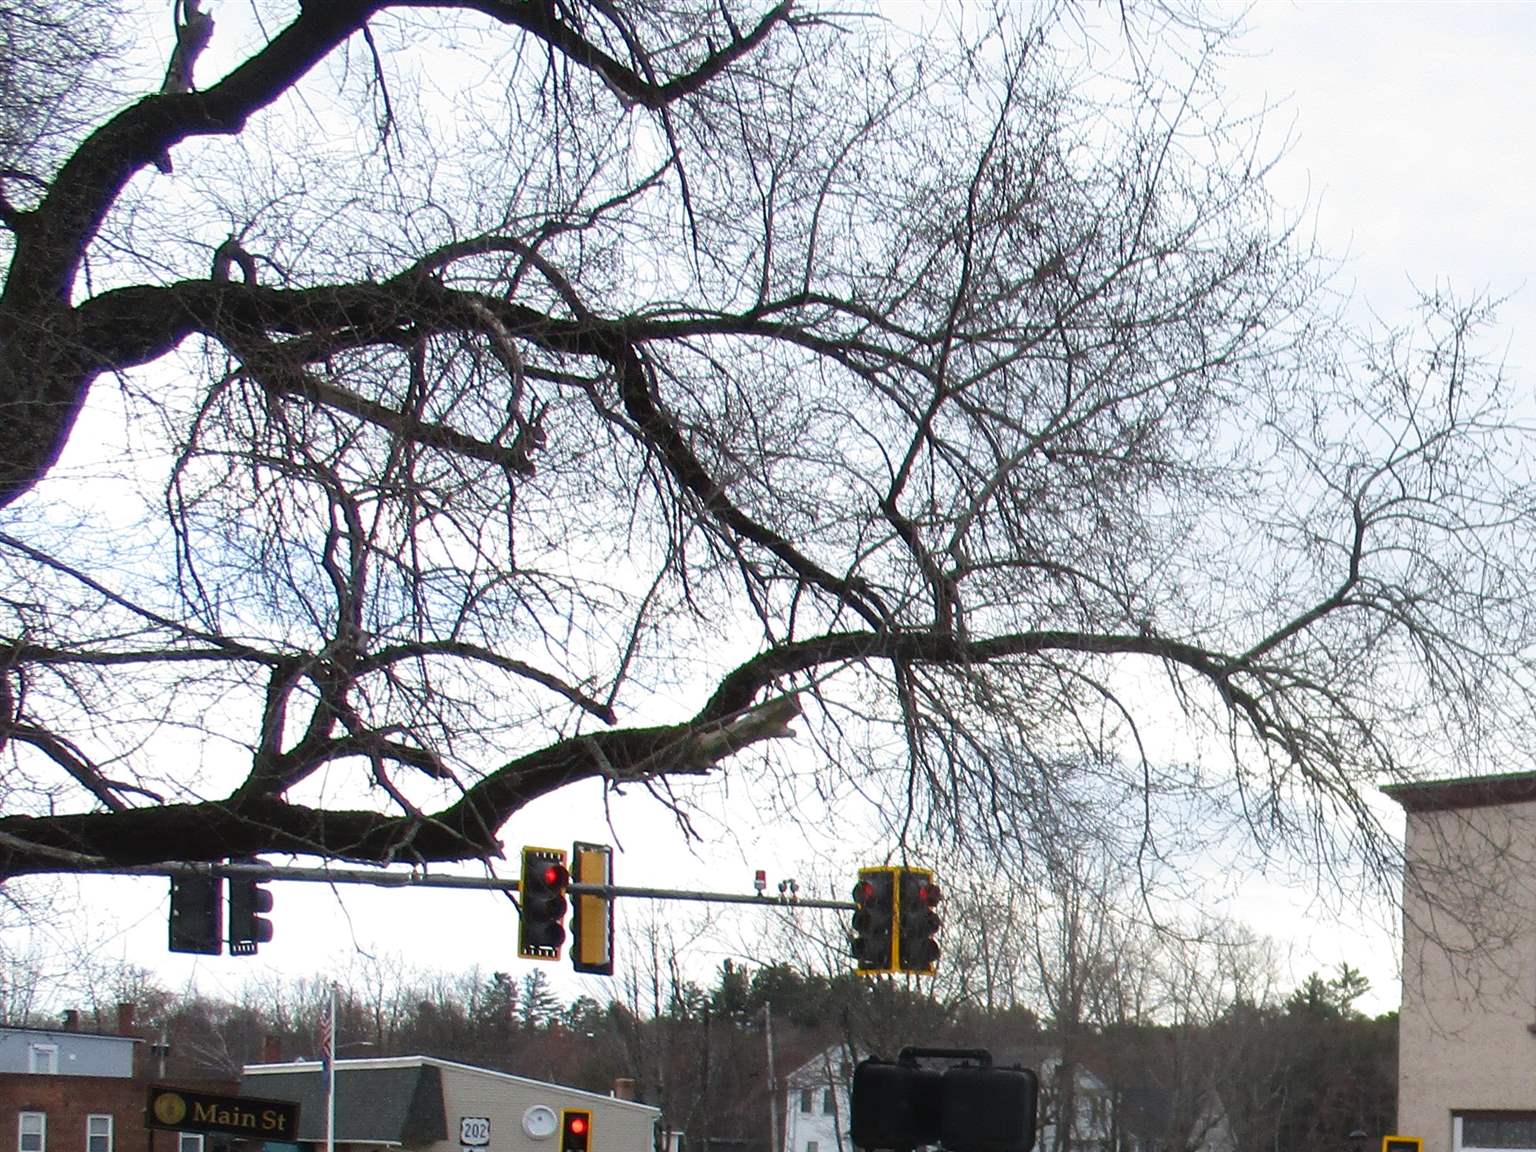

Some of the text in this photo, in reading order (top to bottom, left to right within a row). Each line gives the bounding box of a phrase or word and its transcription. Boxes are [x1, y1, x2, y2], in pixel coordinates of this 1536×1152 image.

[193, 1102, 288, 1131] Main St
[464, 1123, 487, 1138] 202
